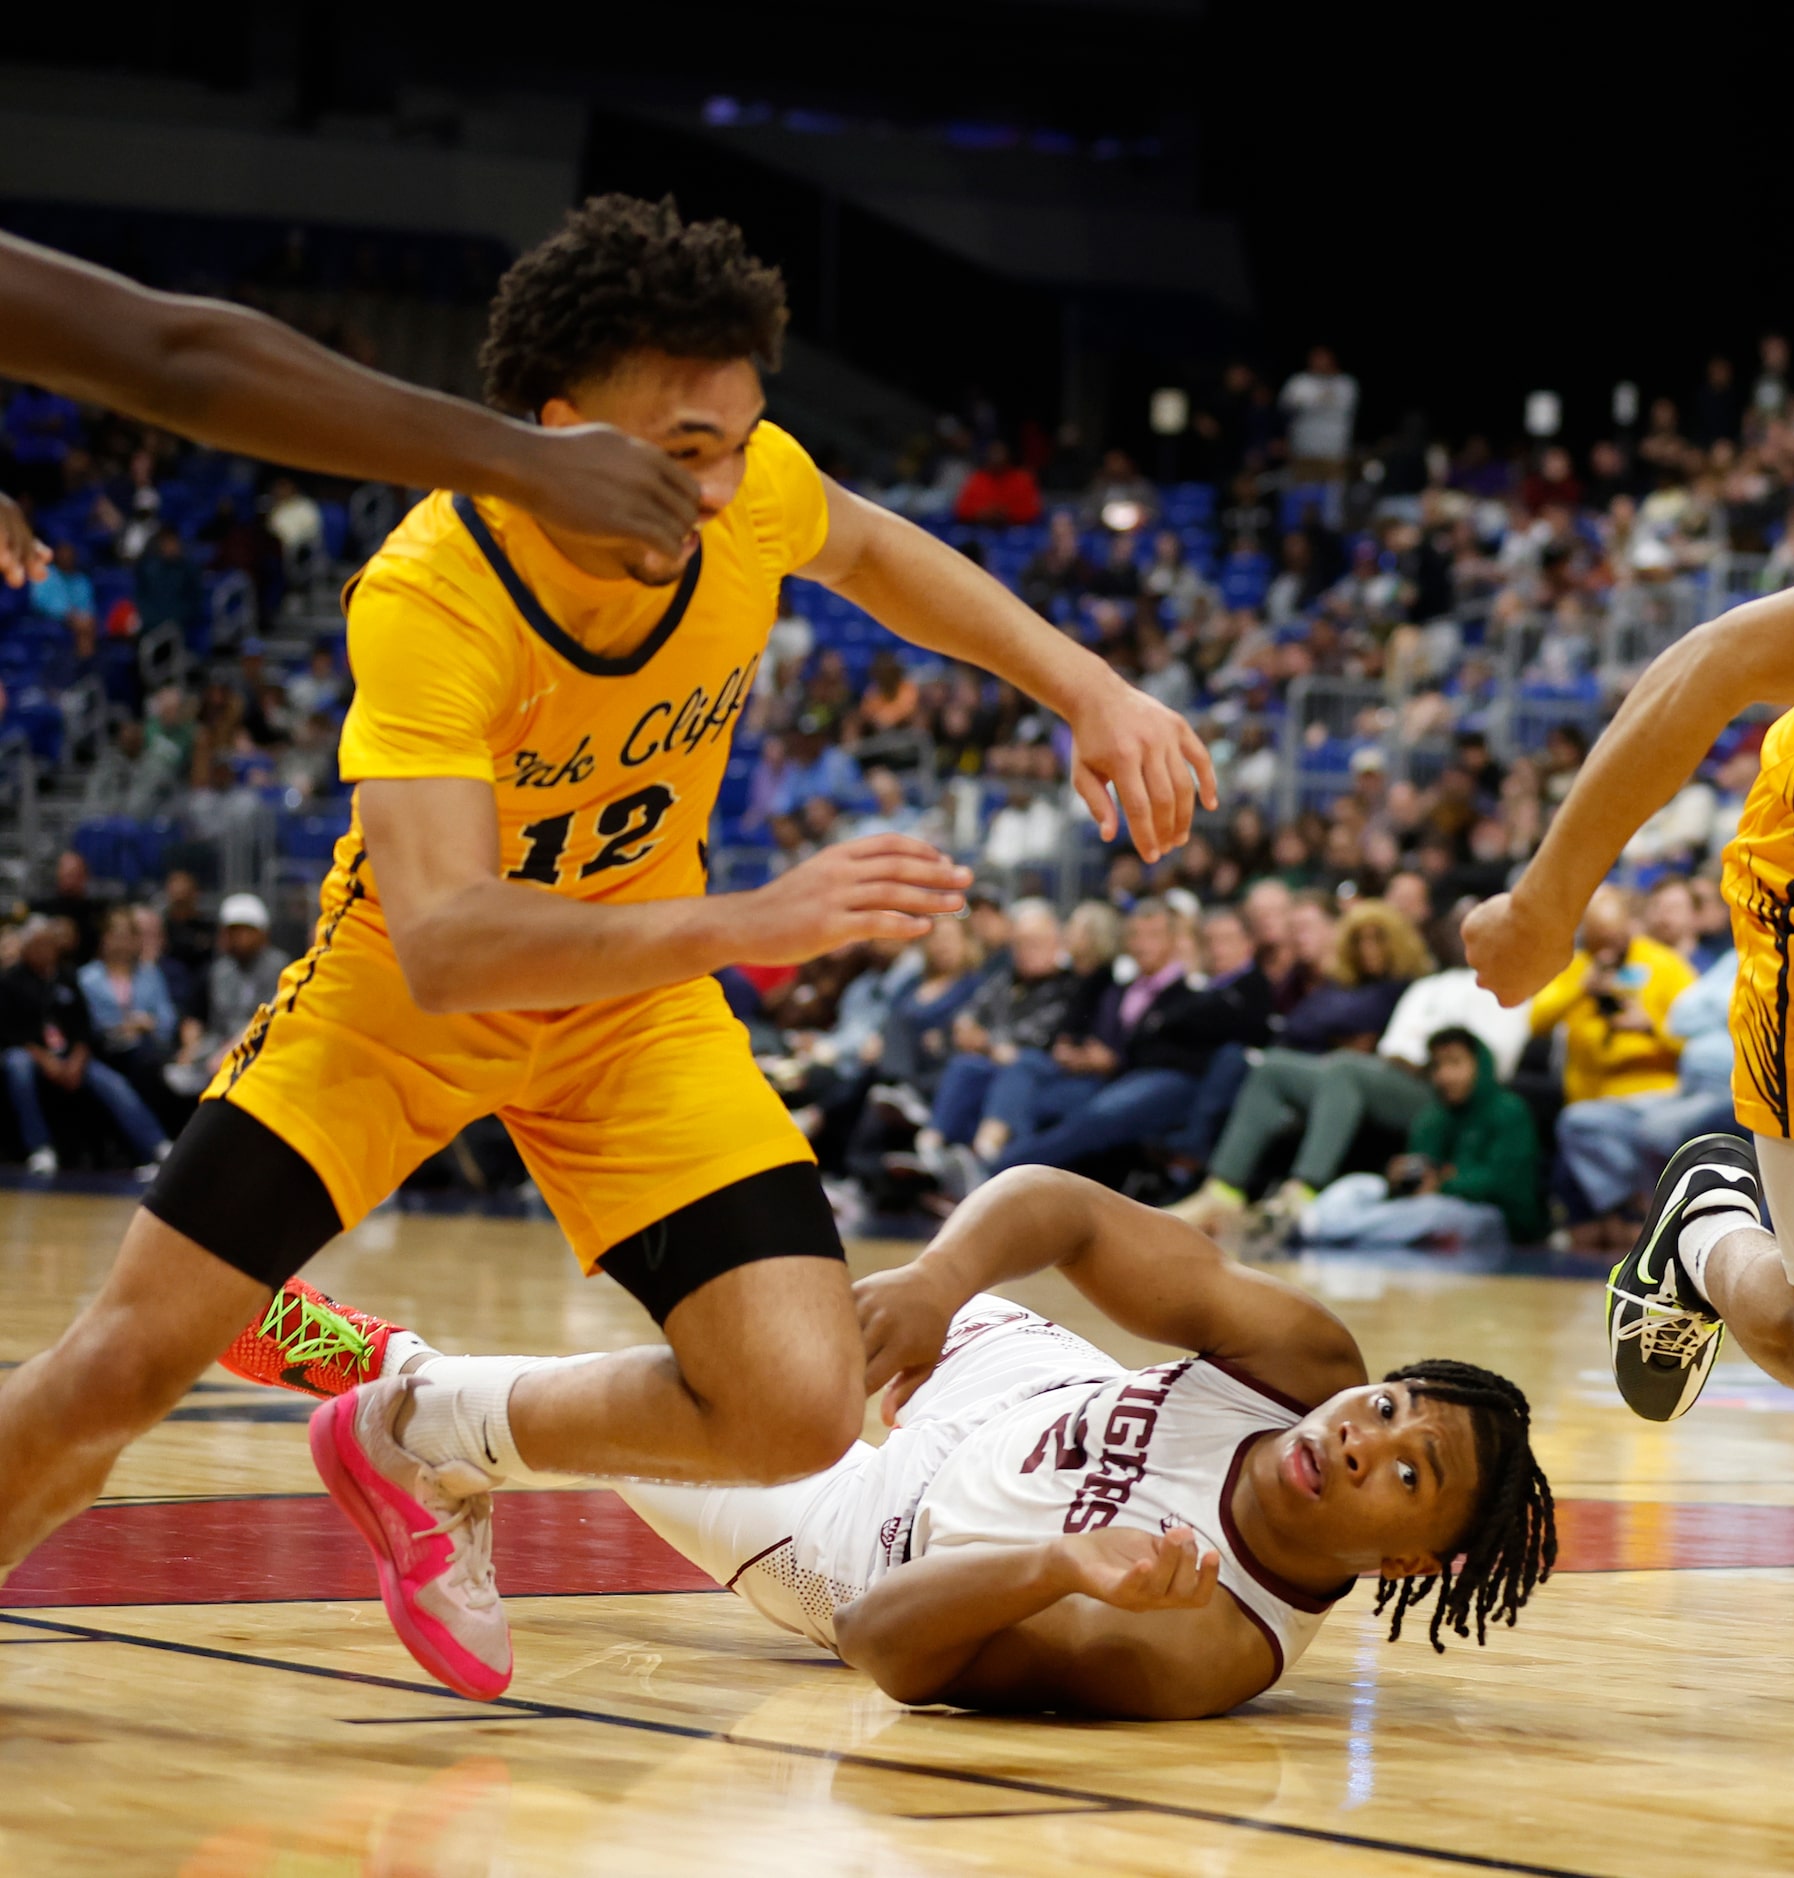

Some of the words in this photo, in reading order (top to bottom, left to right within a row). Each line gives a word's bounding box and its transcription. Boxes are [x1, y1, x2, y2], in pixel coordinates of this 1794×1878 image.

[619, 652, 760, 767] Cliff
[503, 780, 681, 889] 12
[1062, 1361, 1194, 1535] TIGERS
